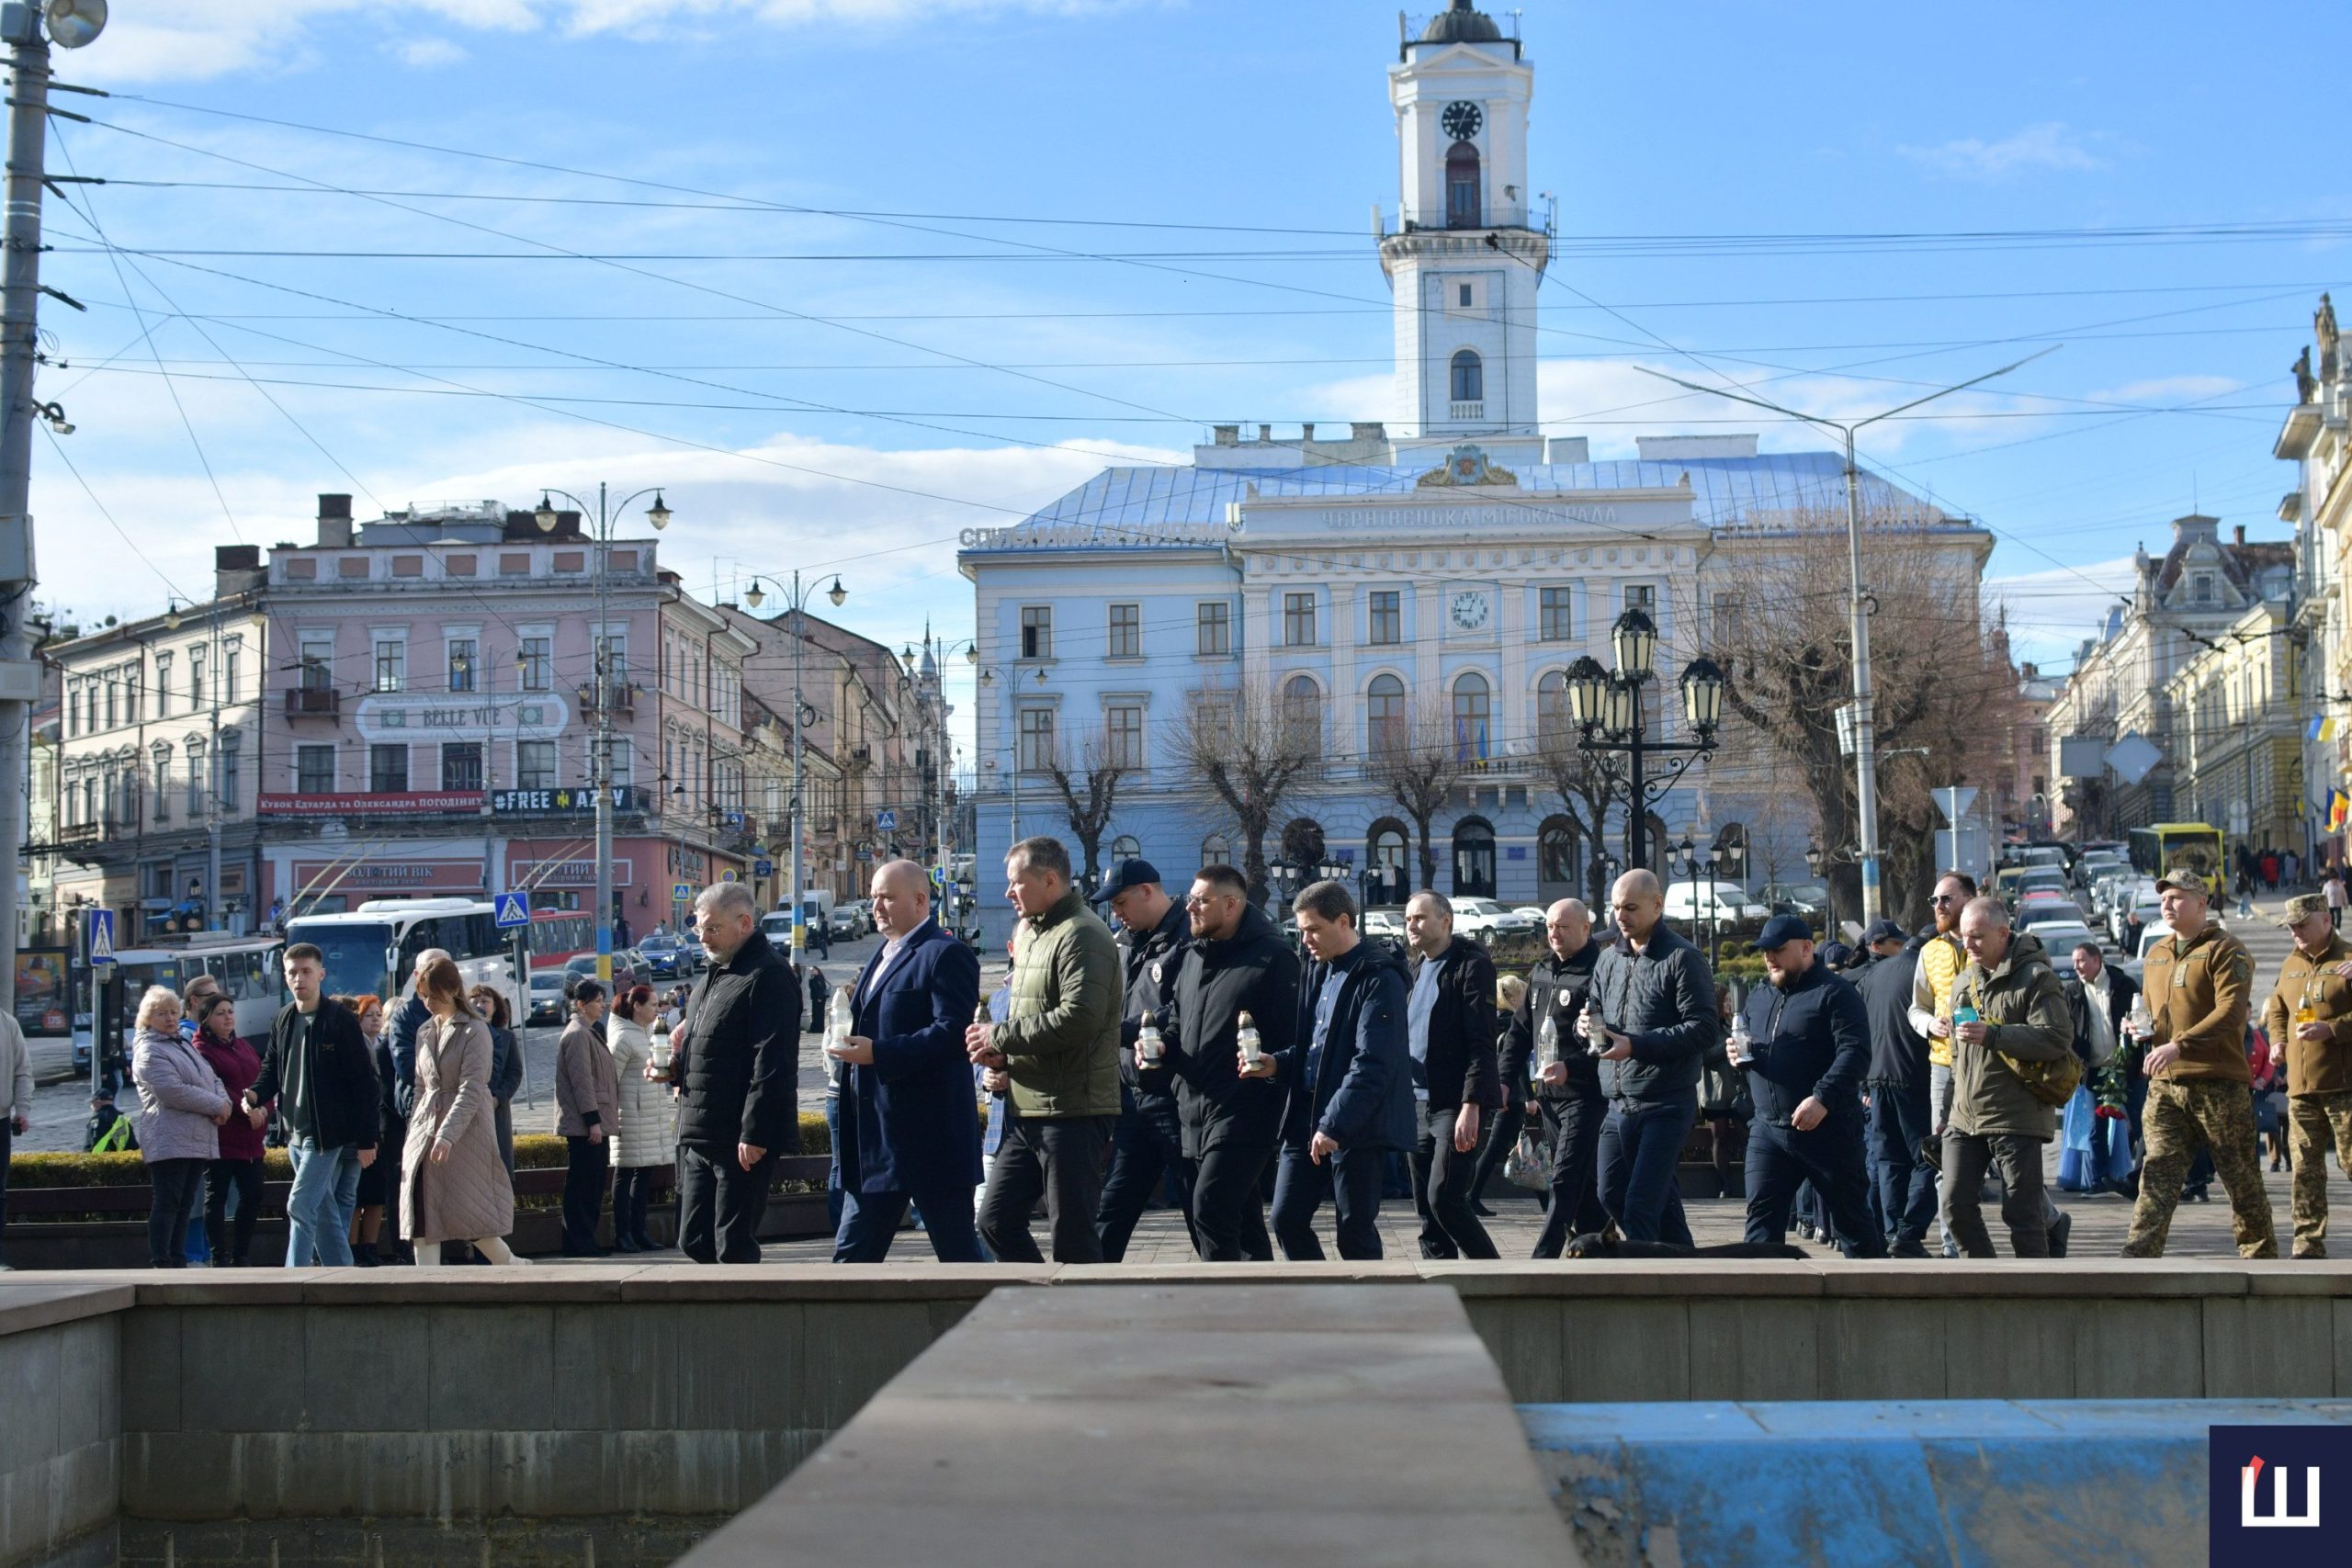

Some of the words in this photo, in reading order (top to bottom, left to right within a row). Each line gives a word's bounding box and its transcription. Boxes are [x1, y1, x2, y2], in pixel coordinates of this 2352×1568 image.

[1323, 510, 1472, 527] ЧЕРНІВЕЦЬКА
[1481, 507, 1558, 524] МІСЬКА
[1566, 506, 1617, 523] РАДА
[424, 709, 466, 727] BELLE
[494, 791, 550, 810] #FREE
[576, 789, 624, 807] AZV
[412, 866, 433, 877] ВІК
